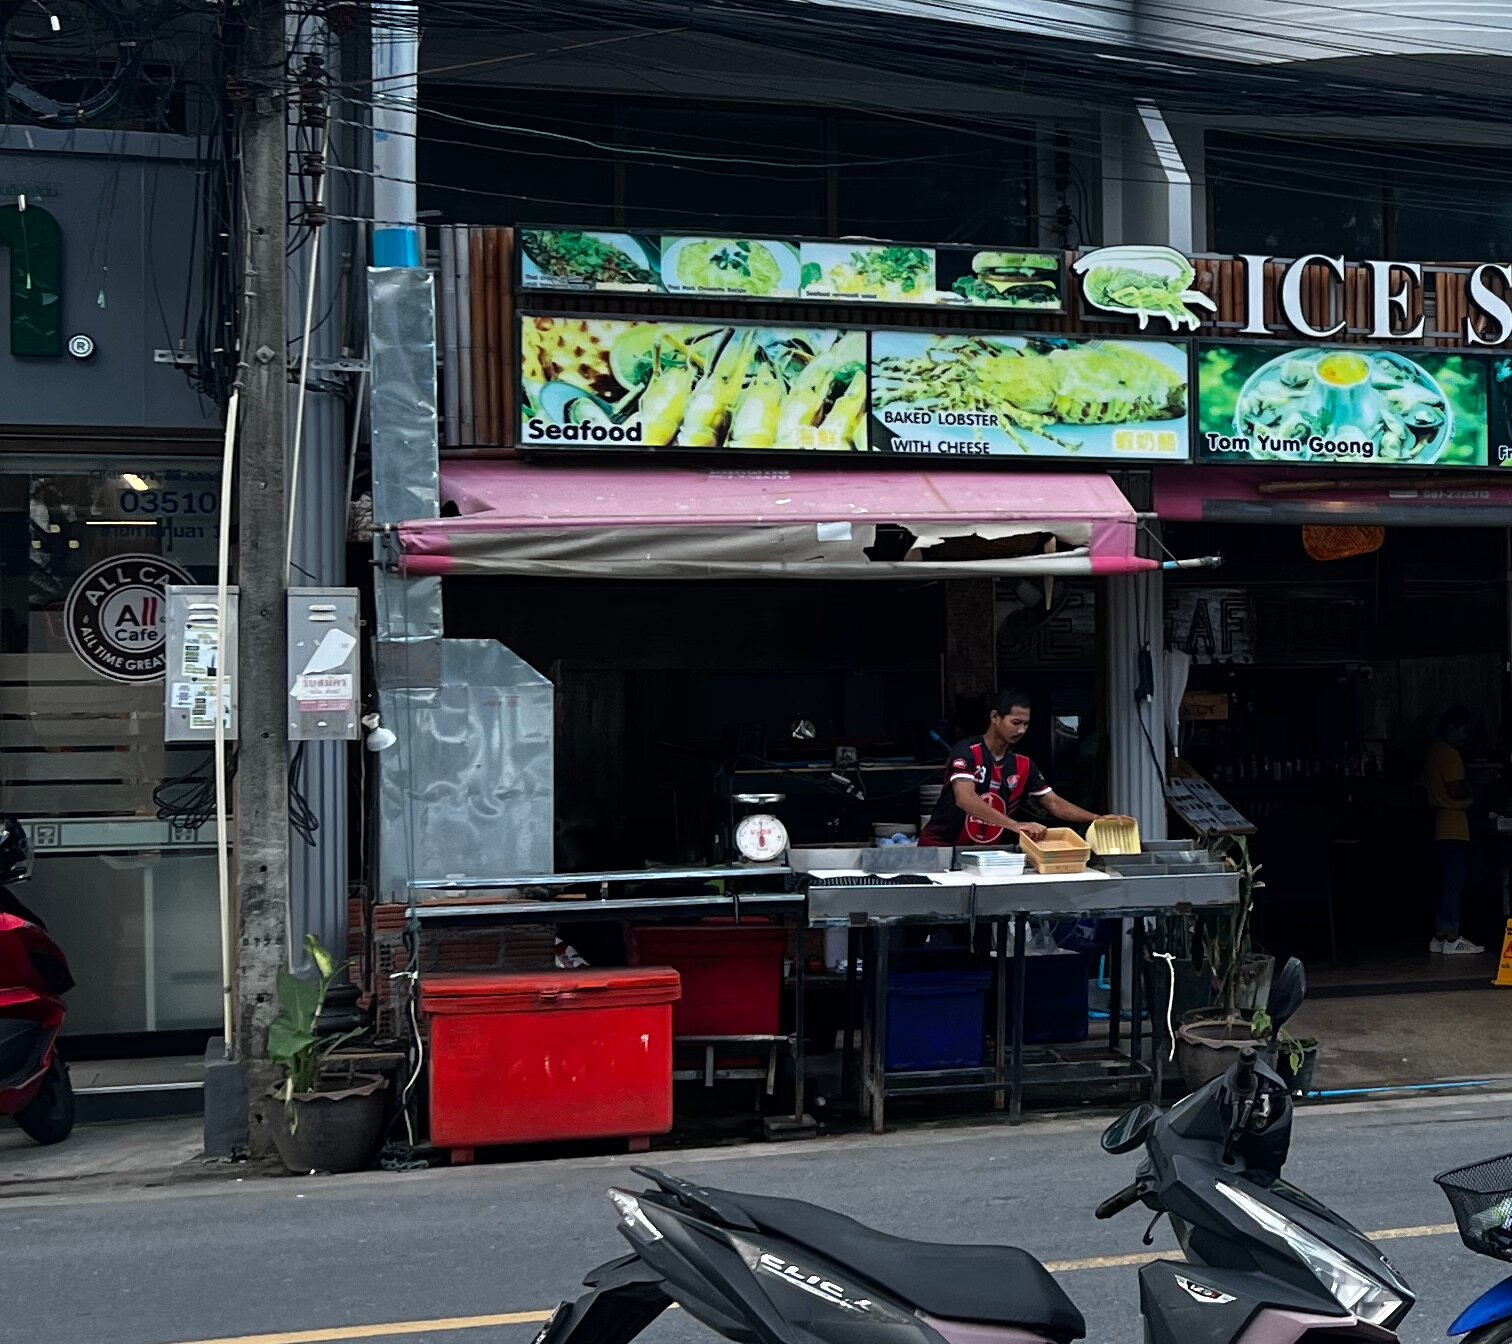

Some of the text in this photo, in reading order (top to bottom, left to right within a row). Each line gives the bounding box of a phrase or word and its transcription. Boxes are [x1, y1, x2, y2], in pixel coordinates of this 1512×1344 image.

[1238, 254, 1426, 340] ICE
[528, 419, 642, 442] Seafood
[884, 411, 999, 427] BAKED LOBSTER
[891, 437, 991, 455] WITH CHEESE
[1207, 432, 1374, 458] Tom Yum Goong
[120, 491, 217, 514] 03510
[85, 567, 132, 606] ALL
[115, 597, 157, 627] All
[94, 645, 124, 669] TIME
